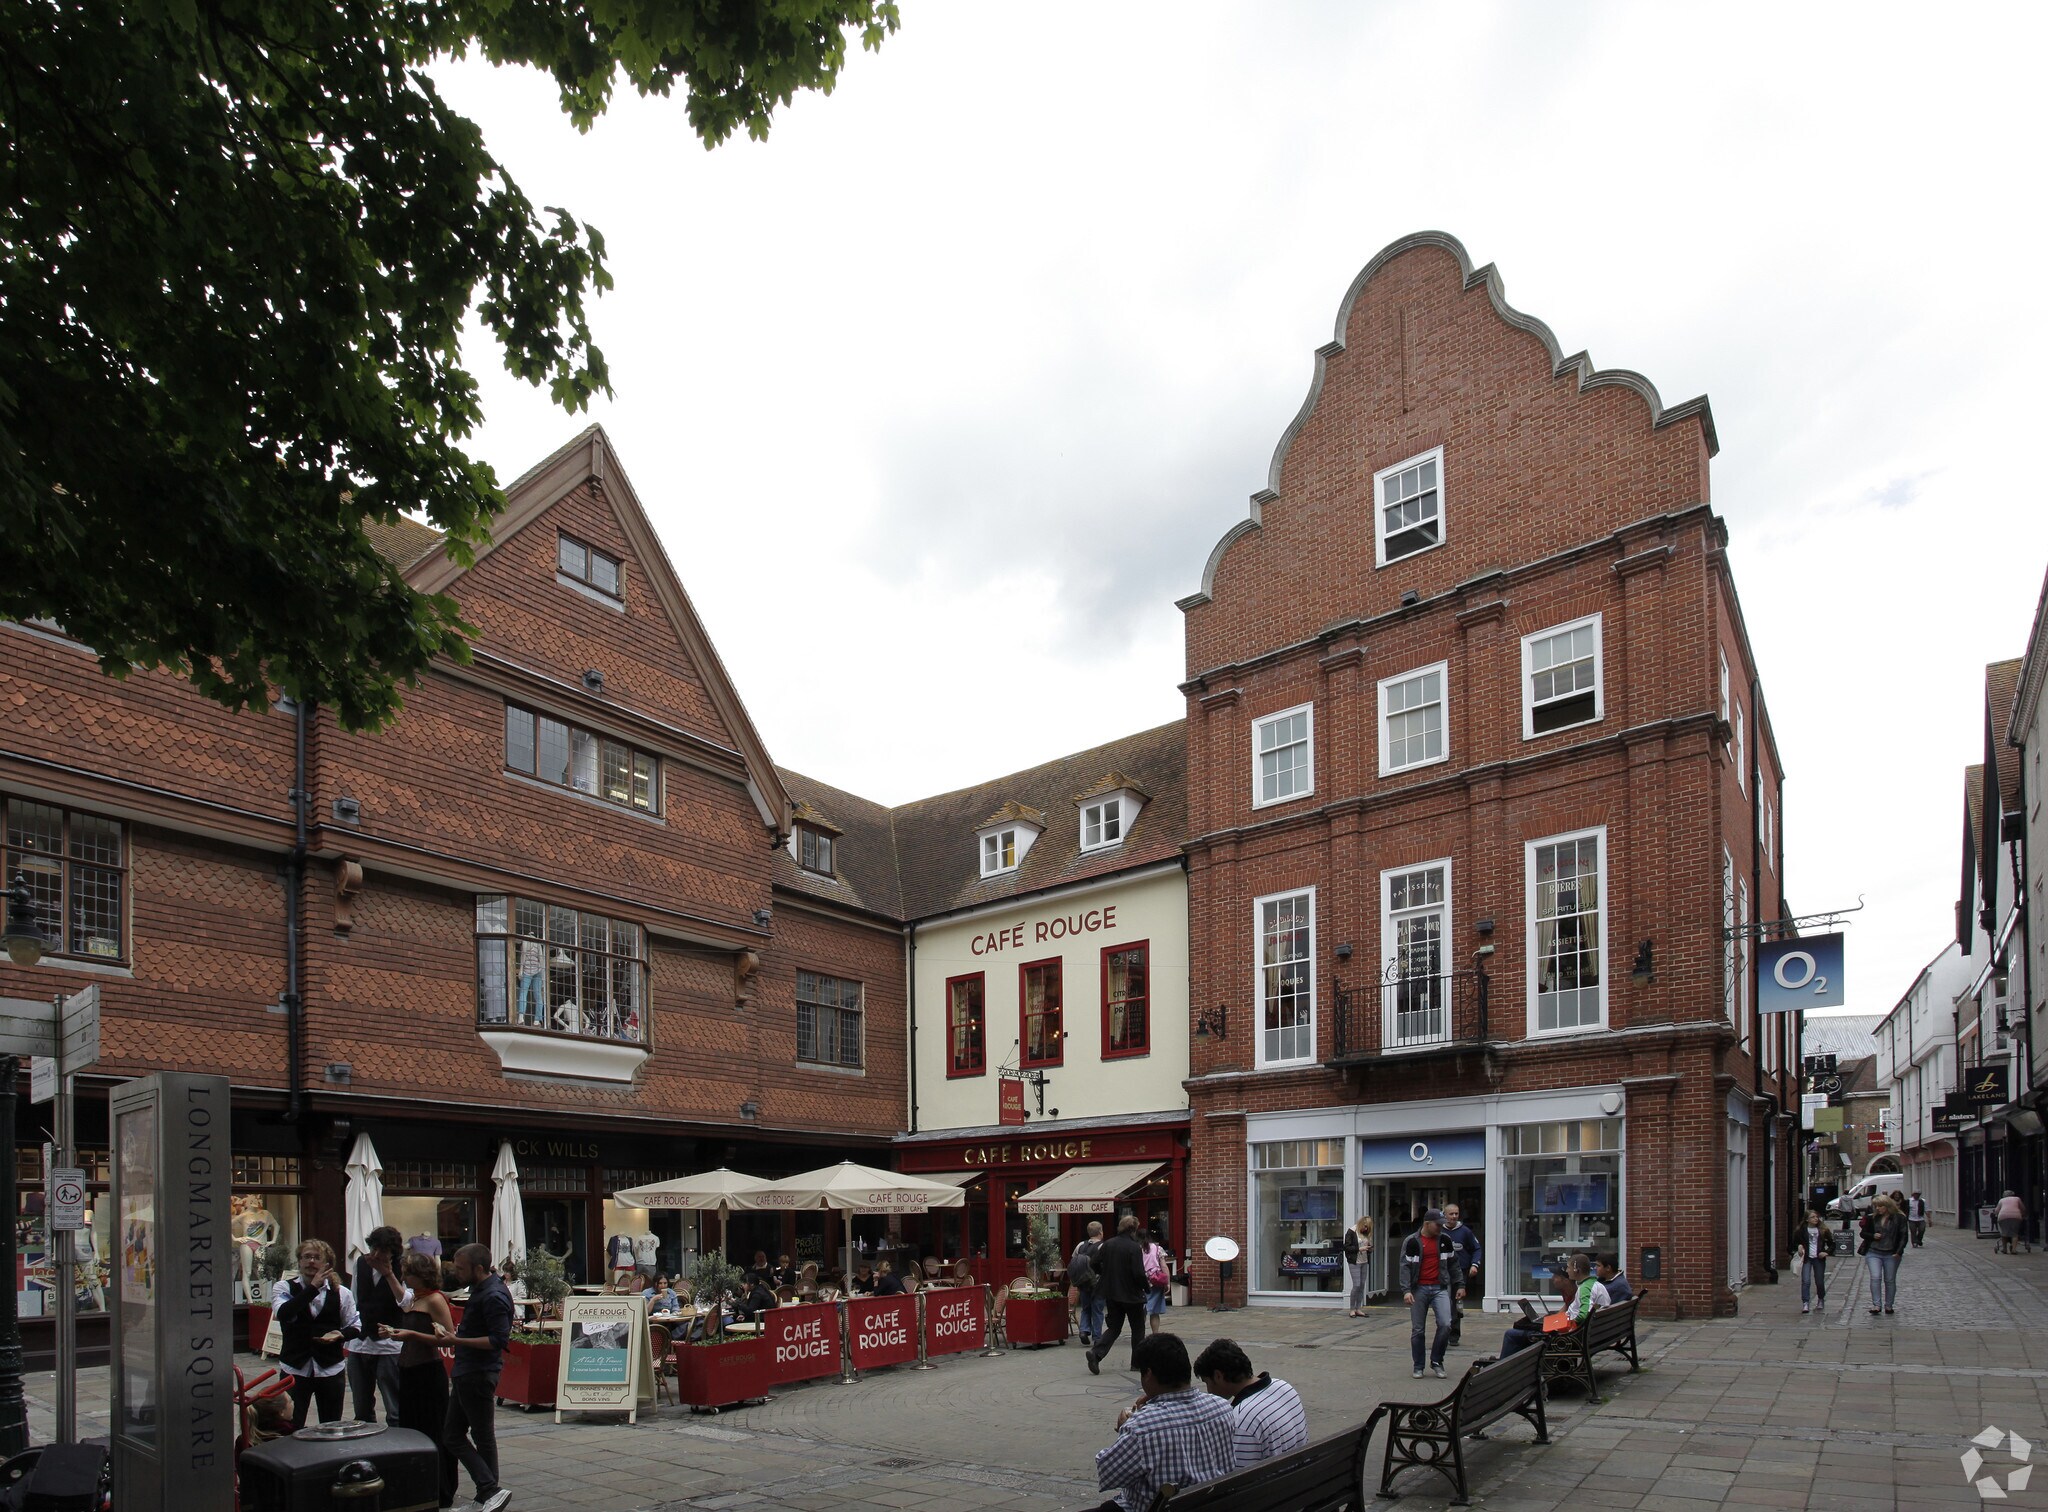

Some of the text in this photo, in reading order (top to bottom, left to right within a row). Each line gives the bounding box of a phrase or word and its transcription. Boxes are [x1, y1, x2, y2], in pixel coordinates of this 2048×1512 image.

[1549, 879, 1583, 895] BIÈRES
[971, 905, 1117, 956] CAFÉ ROUGE
[1968, 1092, 2006, 1101] LAKELAND
[1004, 1102, 1022, 1111] ROUGE
[547, 1141, 599, 1159] WILLS
[1020, 1140, 1092, 1162] ROUGE
[664, 1195, 690, 1206] ROUGE
[772, 1194, 795, 1206] ROUGE
[868, 1191, 928, 1204] CAFÉ ROUGE
[1069, 1203, 1083, 1212] BAR
[795, 1236, 822, 1249] PROUD
[1302, 1256, 1338, 1265] PRIORITY
[185, 1086, 217, 1470] LONGMARKET SQUARE
[600, 1308, 627, 1316] ROUGE
[940, 1299, 971, 1319] CAFÉ
[864, 1309, 900, 1330] CAFÉ
[935, 1317, 977, 1338] ROUGE
[783, 1318, 821, 1342] CAFÉ
[859, 1328, 907, 1350] ROUGE
[775, 1338, 830, 1363] ROUGE
